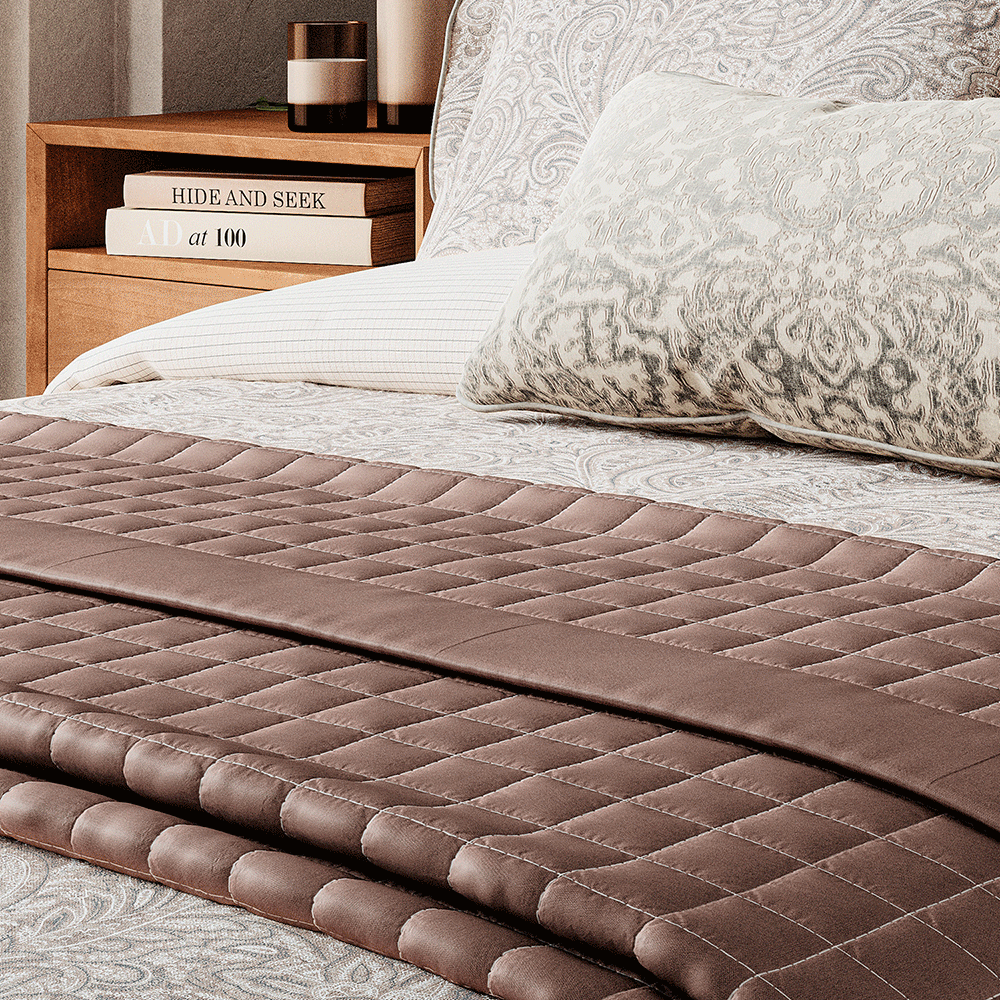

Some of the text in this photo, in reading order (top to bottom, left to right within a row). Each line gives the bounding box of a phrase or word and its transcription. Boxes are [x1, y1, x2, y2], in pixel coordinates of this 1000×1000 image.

[172, 187, 326, 210] HIDE AND SEEK
[138, 219, 247, 248] AD at 100
